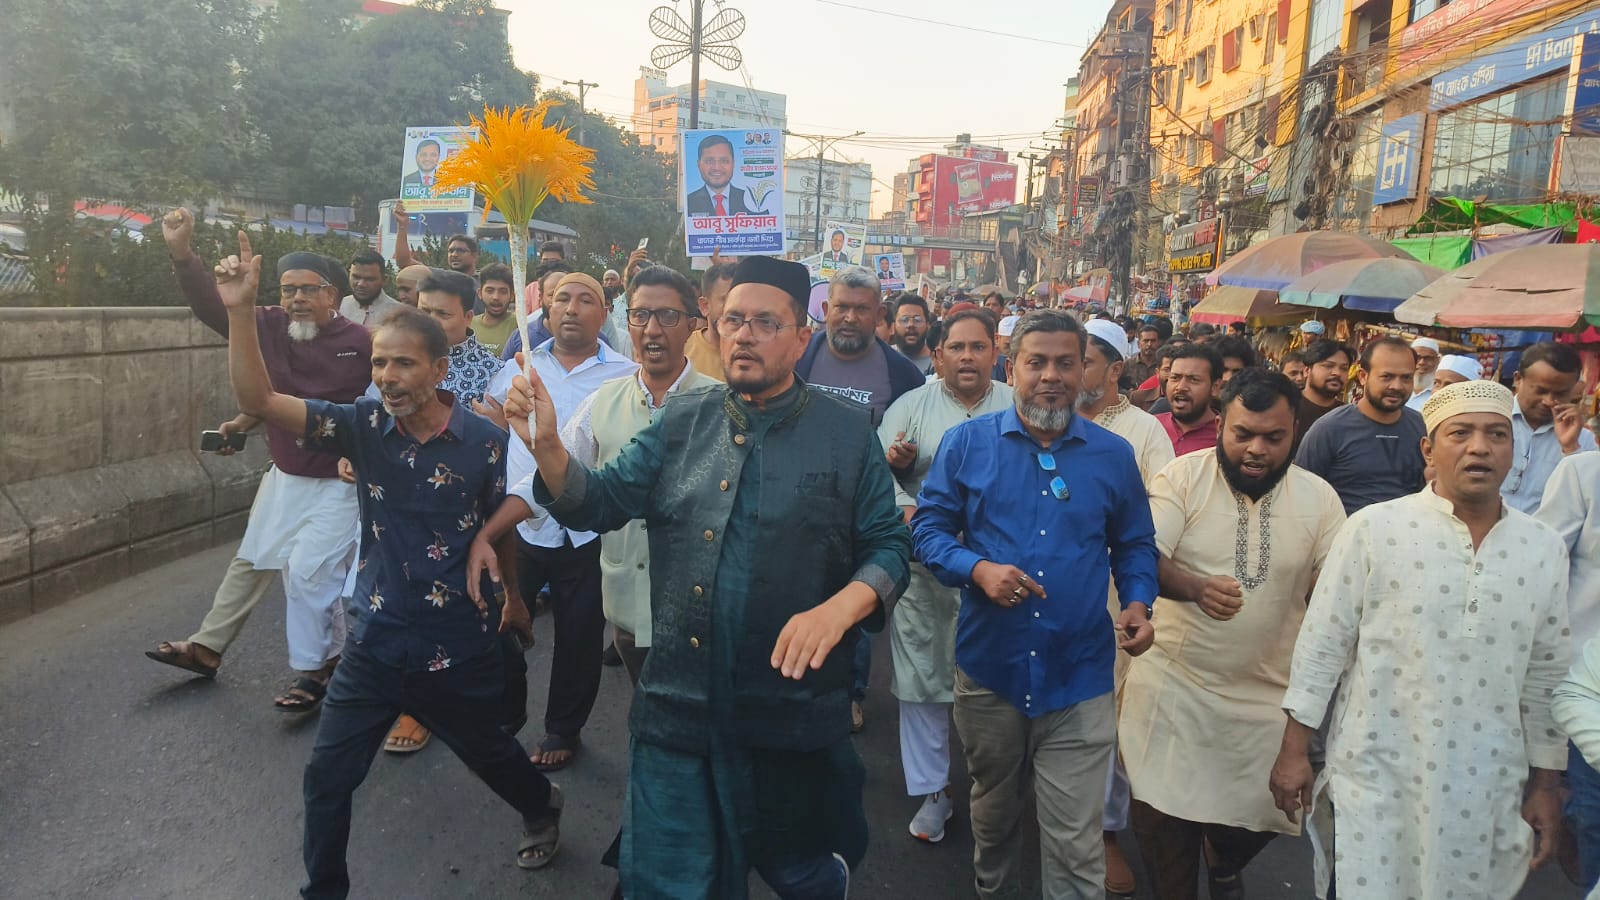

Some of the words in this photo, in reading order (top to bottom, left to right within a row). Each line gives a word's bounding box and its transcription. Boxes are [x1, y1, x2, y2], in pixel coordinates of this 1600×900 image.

[1446, 75, 1470, 96] ব্যাংক
[1470, 64, 1496, 88] এশিয়া
[692, 216, 724, 233] আবু
[725, 212, 777, 233] সুফিয়ান
